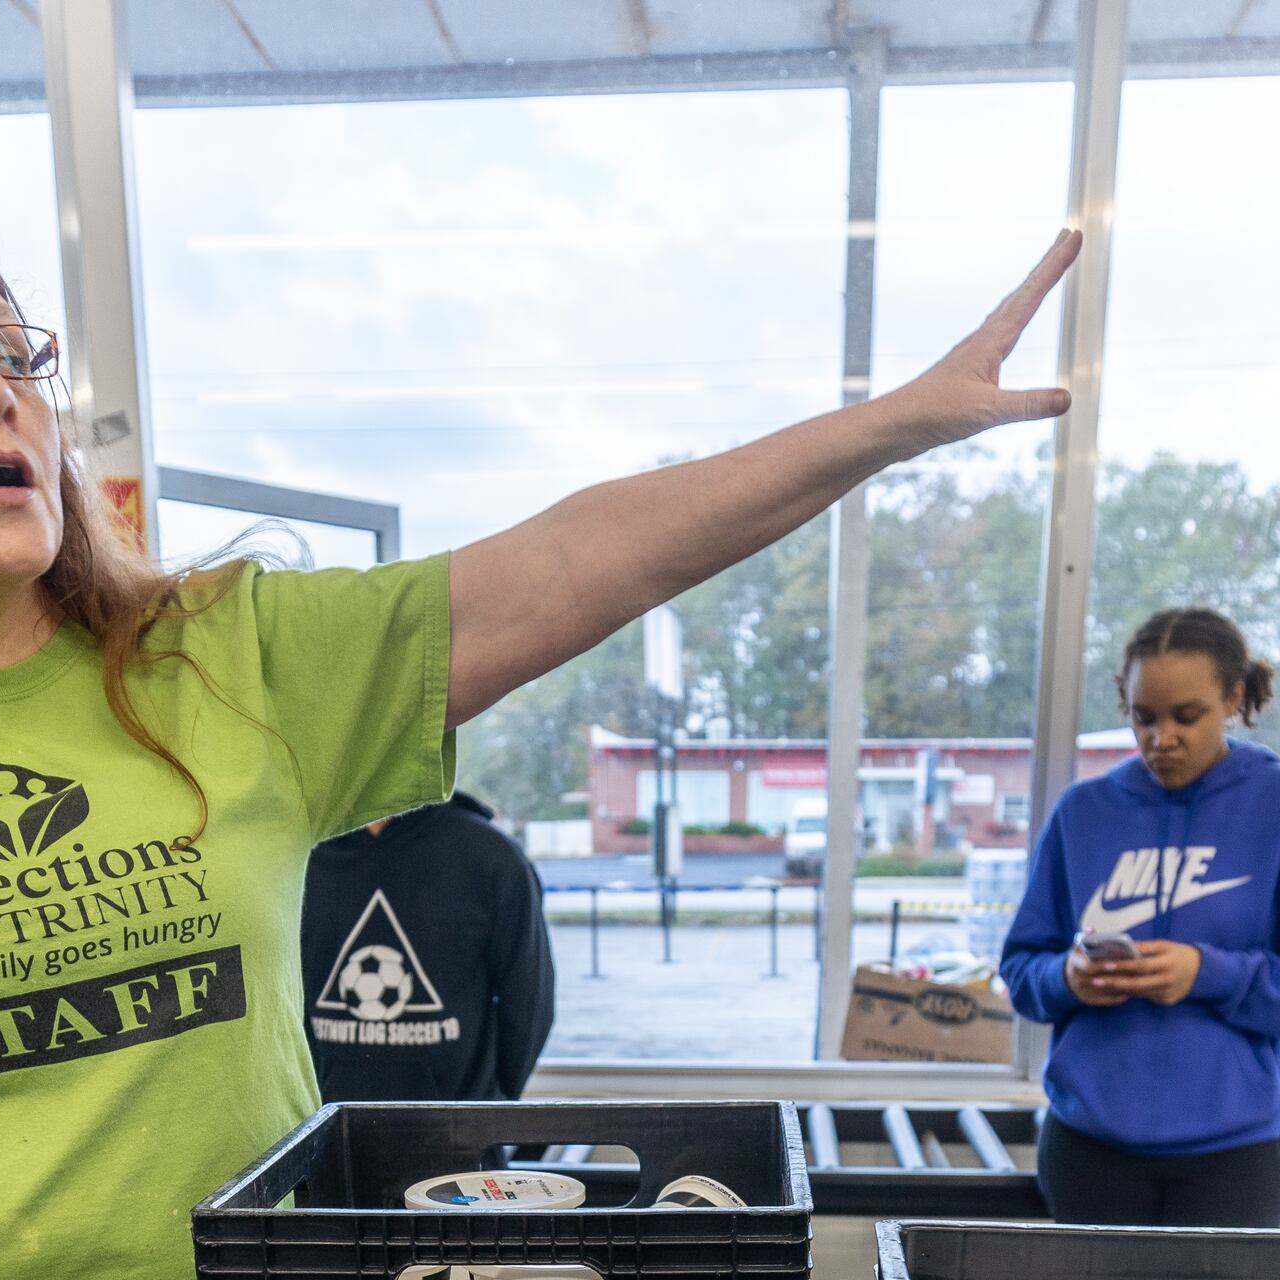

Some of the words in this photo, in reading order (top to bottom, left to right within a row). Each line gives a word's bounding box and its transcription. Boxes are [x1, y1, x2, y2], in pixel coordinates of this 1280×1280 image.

[1103, 846, 1217, 902] NIKE
[45, 937, 112, 975] goes
[123, 912, 223, 952] hungry
[359, 1022, 387, 1044] LOG
[388, 1020, 442, 1045] SOCCER
